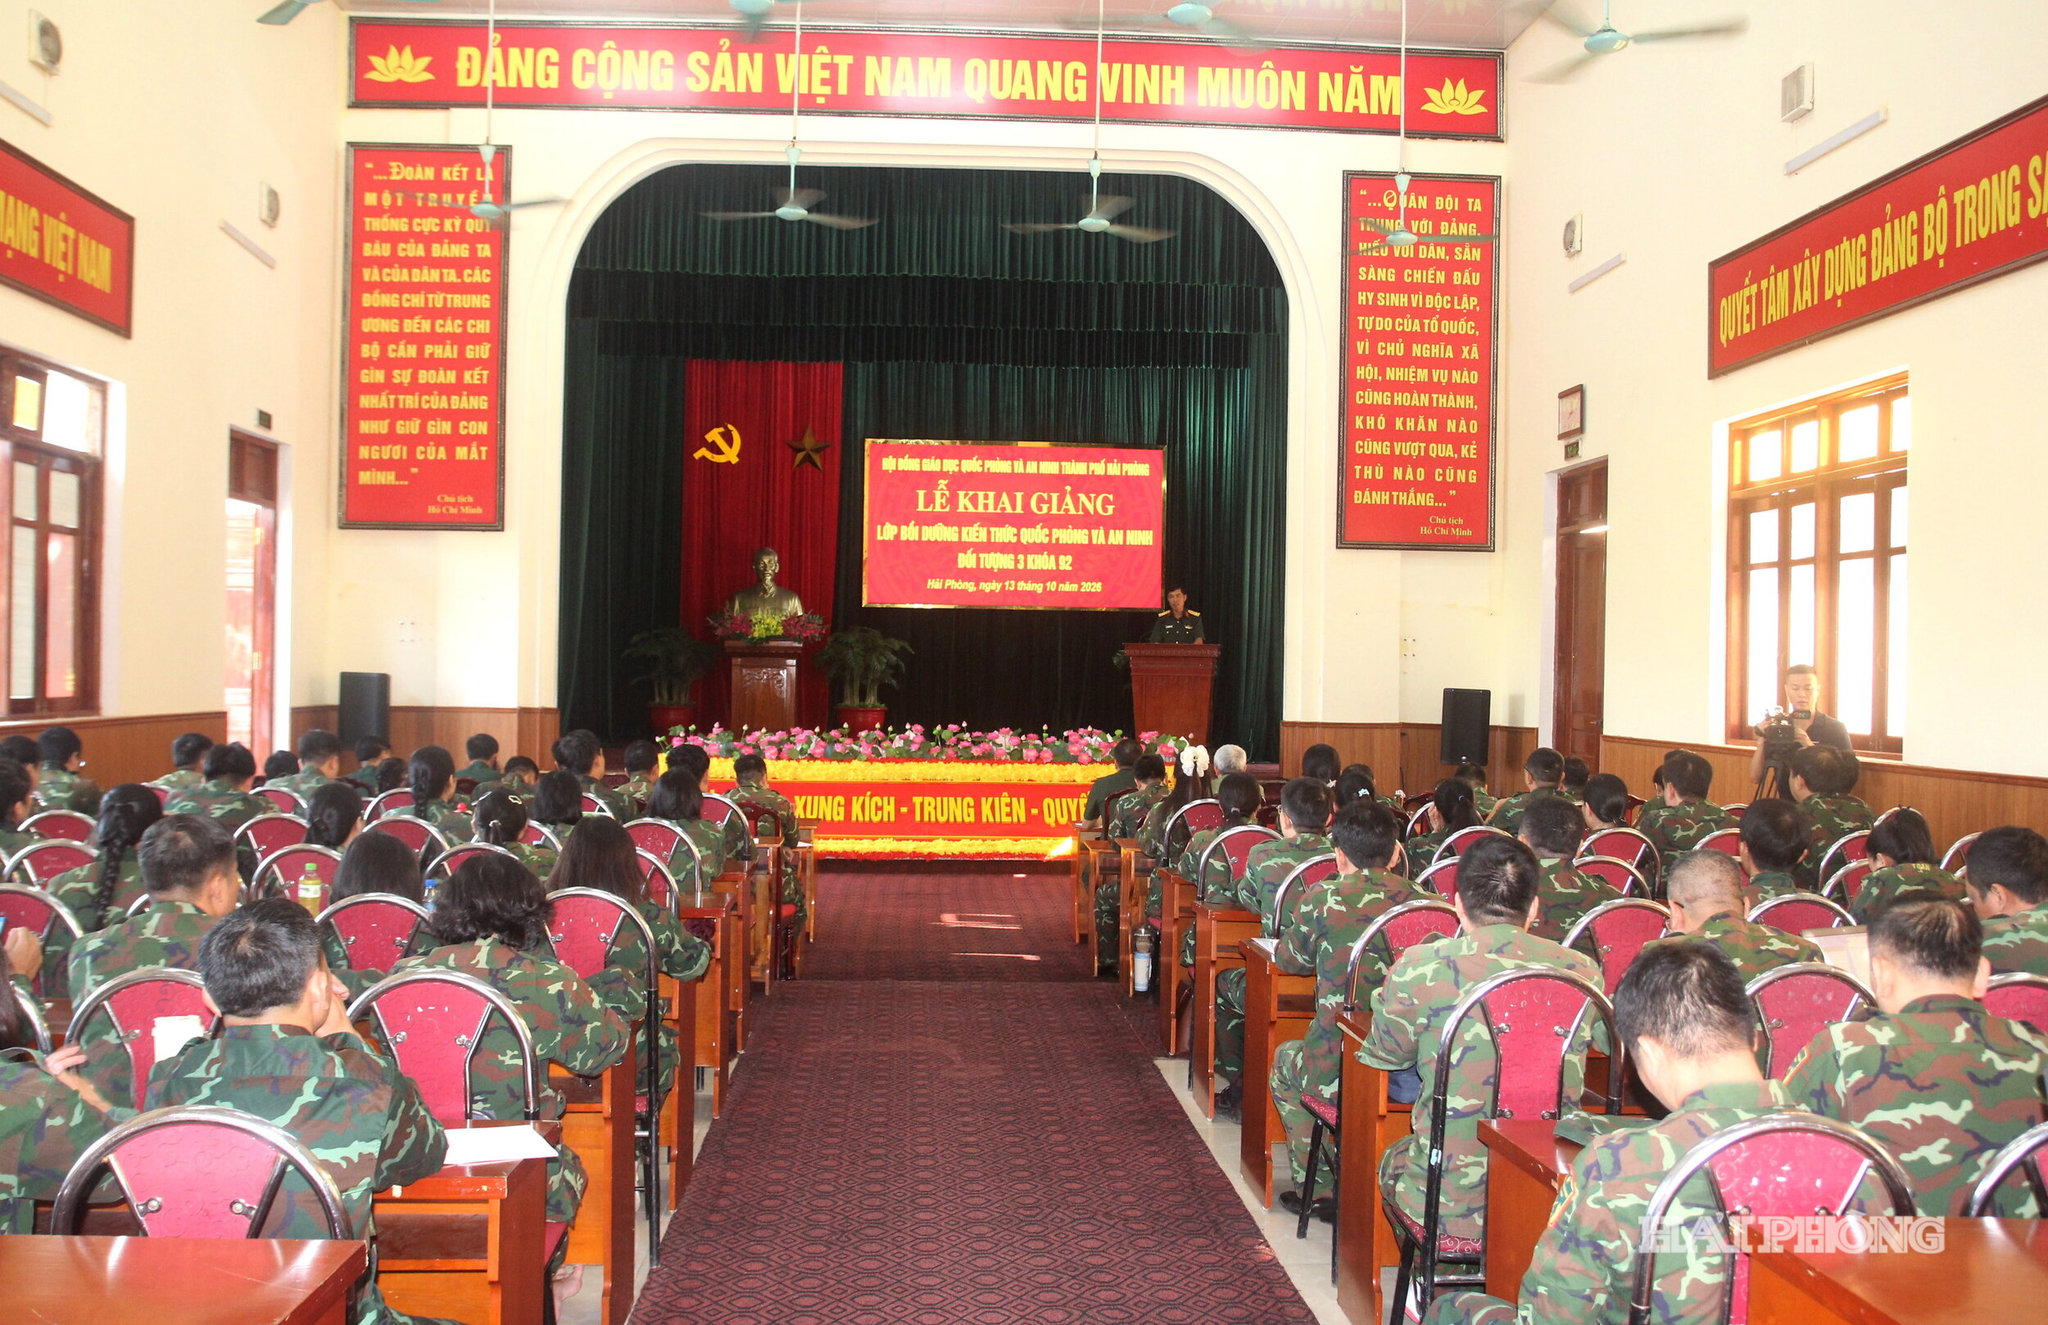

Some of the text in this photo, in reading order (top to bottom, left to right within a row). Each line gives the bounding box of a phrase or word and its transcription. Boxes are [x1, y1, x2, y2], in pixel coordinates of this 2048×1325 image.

[456, 32, 1401, 115] ĐẢNG CỘNG SẢN VIỆT NAM QUANG VINH MUÔN NĂM
[442, 164, 469, 180] KẾT
[1435, 195, 1481, 213] ĐỘI TA
[364, 214, 461, 234] THỐNG CỰC KỲ
[1410, 218, 1432, 235] VỚI
[43, 212, 76, 281] VIỆT
[78, 233, 112, 293] NAM
[398, 239, 425, 257] CỦA
[432, 240, 469, 257] ĐẢNG
[476, 244, 491, 257] TA
[1419, 243, 1449, 261] DÂN,
[1720, 165, 2022, 347] QUYẾT TÂM XÂY DỰNG ĐẢNG BỘ TRONG
[363, 266, 380, 281] VÀ
[382, 264, 412, 282] CỦA
[412, 266, 440, 282] DÂN
[463, 267, 491, 282] CÁC
[1359, 265, 1480, 285] SÀNG CHIẾN ĐẤU
[446, 294, 490, 307] TRUNG
[1358, 292, 1374, 305] HY
[1377, 293, 1408, 306] SINH
[1426, 293, 1451, 311] ĐỘC
[1454, 294, 1479, 312] LẬP,
[403, 316, 431, 332] ĐẾN
[435, 317, 462, 333] CÁC
[467, 320, 490, 333] CHI
[1357, 316, 1374, 332] TỰ
[1376, 317, 1392, 330] DO
[1395, 314, 1421, 332] CỦA
[1441, 317, 1479, 336] QUỐC,
[361, 341, 380, 360] BỘ
[1378, 339, 1404, 356] CHỦ
[1412, 343, 1453, 358] NGHĨA
[1462, 344, 1479, 359] XÃ
[464, 367, 489, 384] KẾT
[1357, 364, 1478, 385] HỘI, NHIỆM VỤ NÀO
[360, 391, 398, 408] NHẤT
[421, 391, 448, 409] CỦA
[450, 392, 488, 409] ĐẢNG
[1356, 389, 1477, 410] CŨNG HOÀN THÀNH,
[360, 419, 390, 434] NHƯ
[459, 421, 487, 434] CON
[1356, 414, 1477, 433] KHÓ KHĂN NÀO
[416, 442, 446, 460] CỦA
[1356, 439, 1477, 458] CŨNG VƯỢT QUA, KẺ
[1355, 464, 1476, 483] THÙ NÀO CŨNG
[917, 480, 1115, 515] LỄ KHAI GIẢNG
[1354, 488, 1389, 504] ĐÁNH
[961, 522, 987, 542] KIẾN
[1020, 523, 1049, 544] QUỐC
[1091, 527, 1105, 544] VÀ
[1108, 530, 1123, 545] AN
[1126, 530, 1153, 545] NINH
[1017, 554, 1024, 569] 3
[1027, 552, 1056, 570] KHÓA
[1059, 555, 1072, 570] 92
[927, 579, 943, 589] Hải
[979, 580, 1002, 592] ngày
[1004, 581, 1015, 590] 13
[1017, 581, 1043, 593] tháng
[1046, 581, 1056, 591] 10
[1058, 582, 1078, 591] năm
[1080, 582, 1102, 592] 2026
[794, 796, 845, 821] XUNG
[852, 792, 895, 823] KÍCH
[913, 797, 975, 822] TRUNG
[981, 792, 1026, 823] KIÊN
